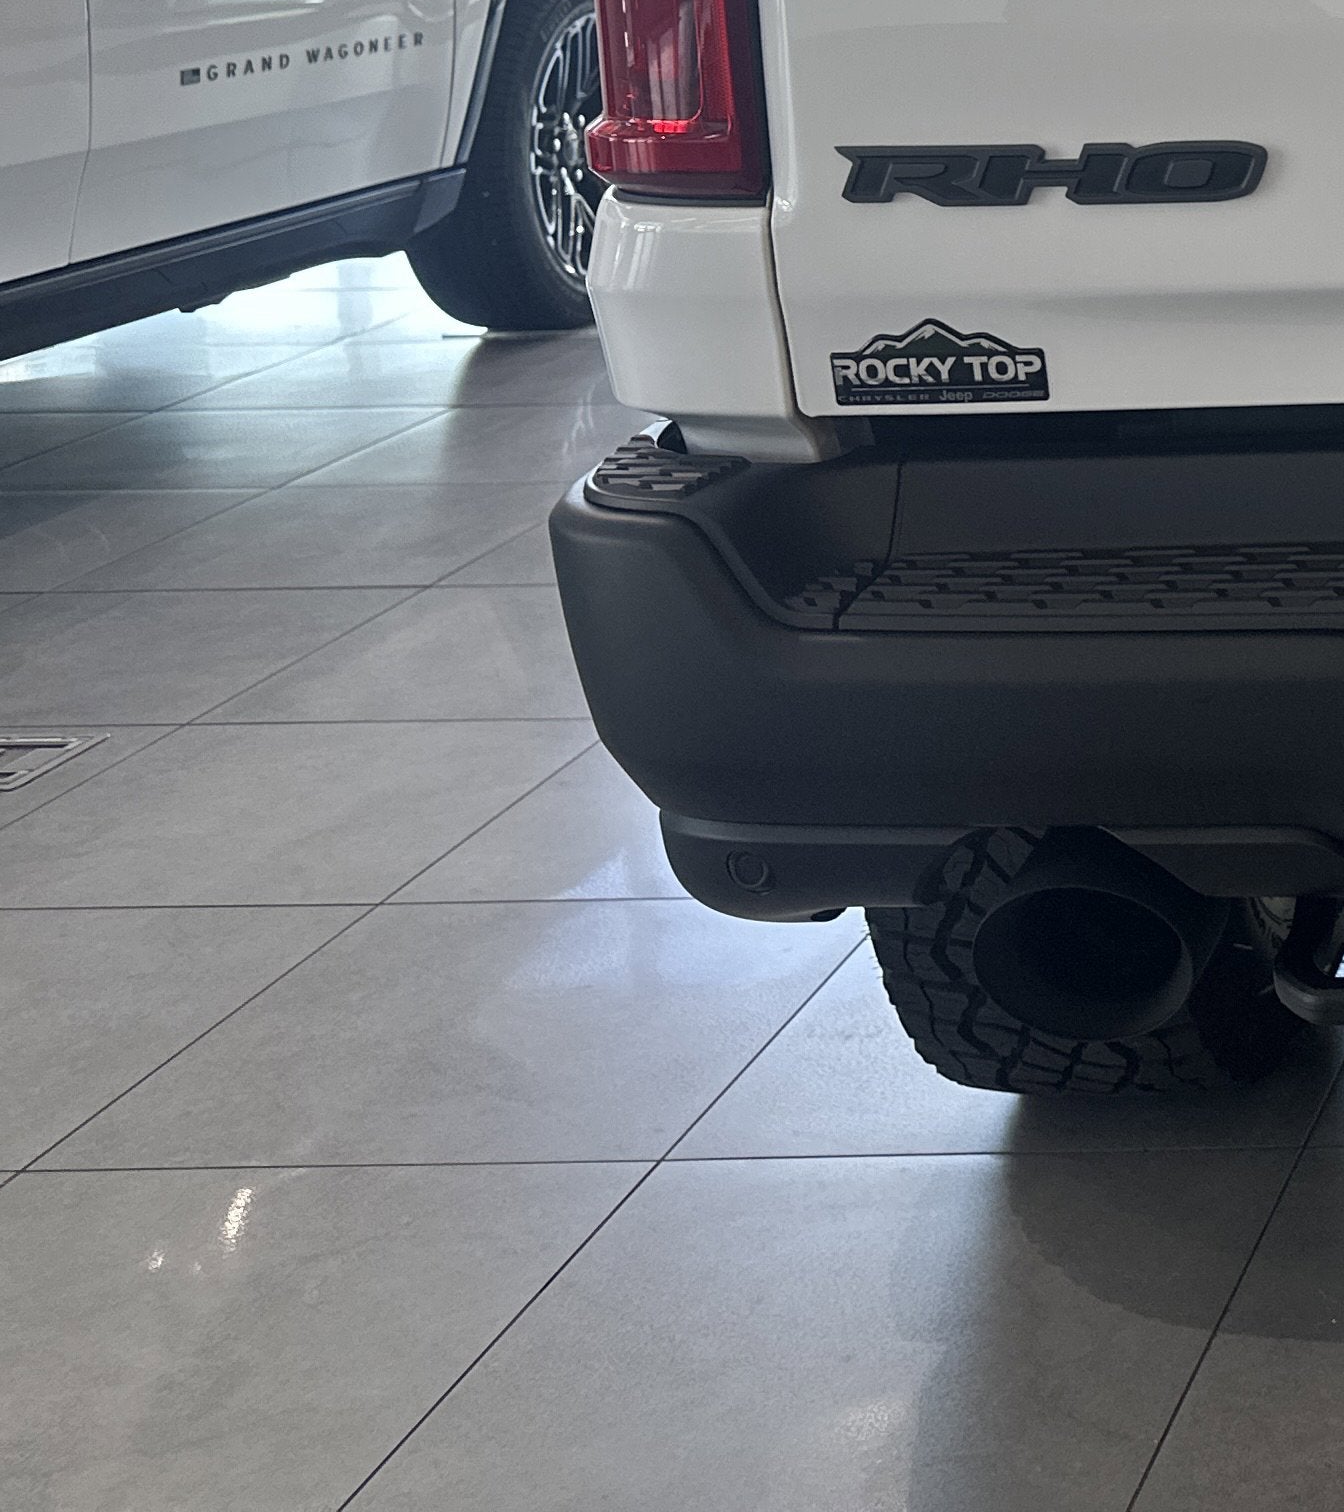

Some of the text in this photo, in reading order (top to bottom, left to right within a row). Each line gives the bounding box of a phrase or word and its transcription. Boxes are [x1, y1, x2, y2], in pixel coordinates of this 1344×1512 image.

[206, 32, 424, 81] GRAND WAGONEER
[834, 140, 1268, 207] RHO
[833, 354, 1042, 385] ROCKY TOP
[939, 390, 973, 403] Jeep
